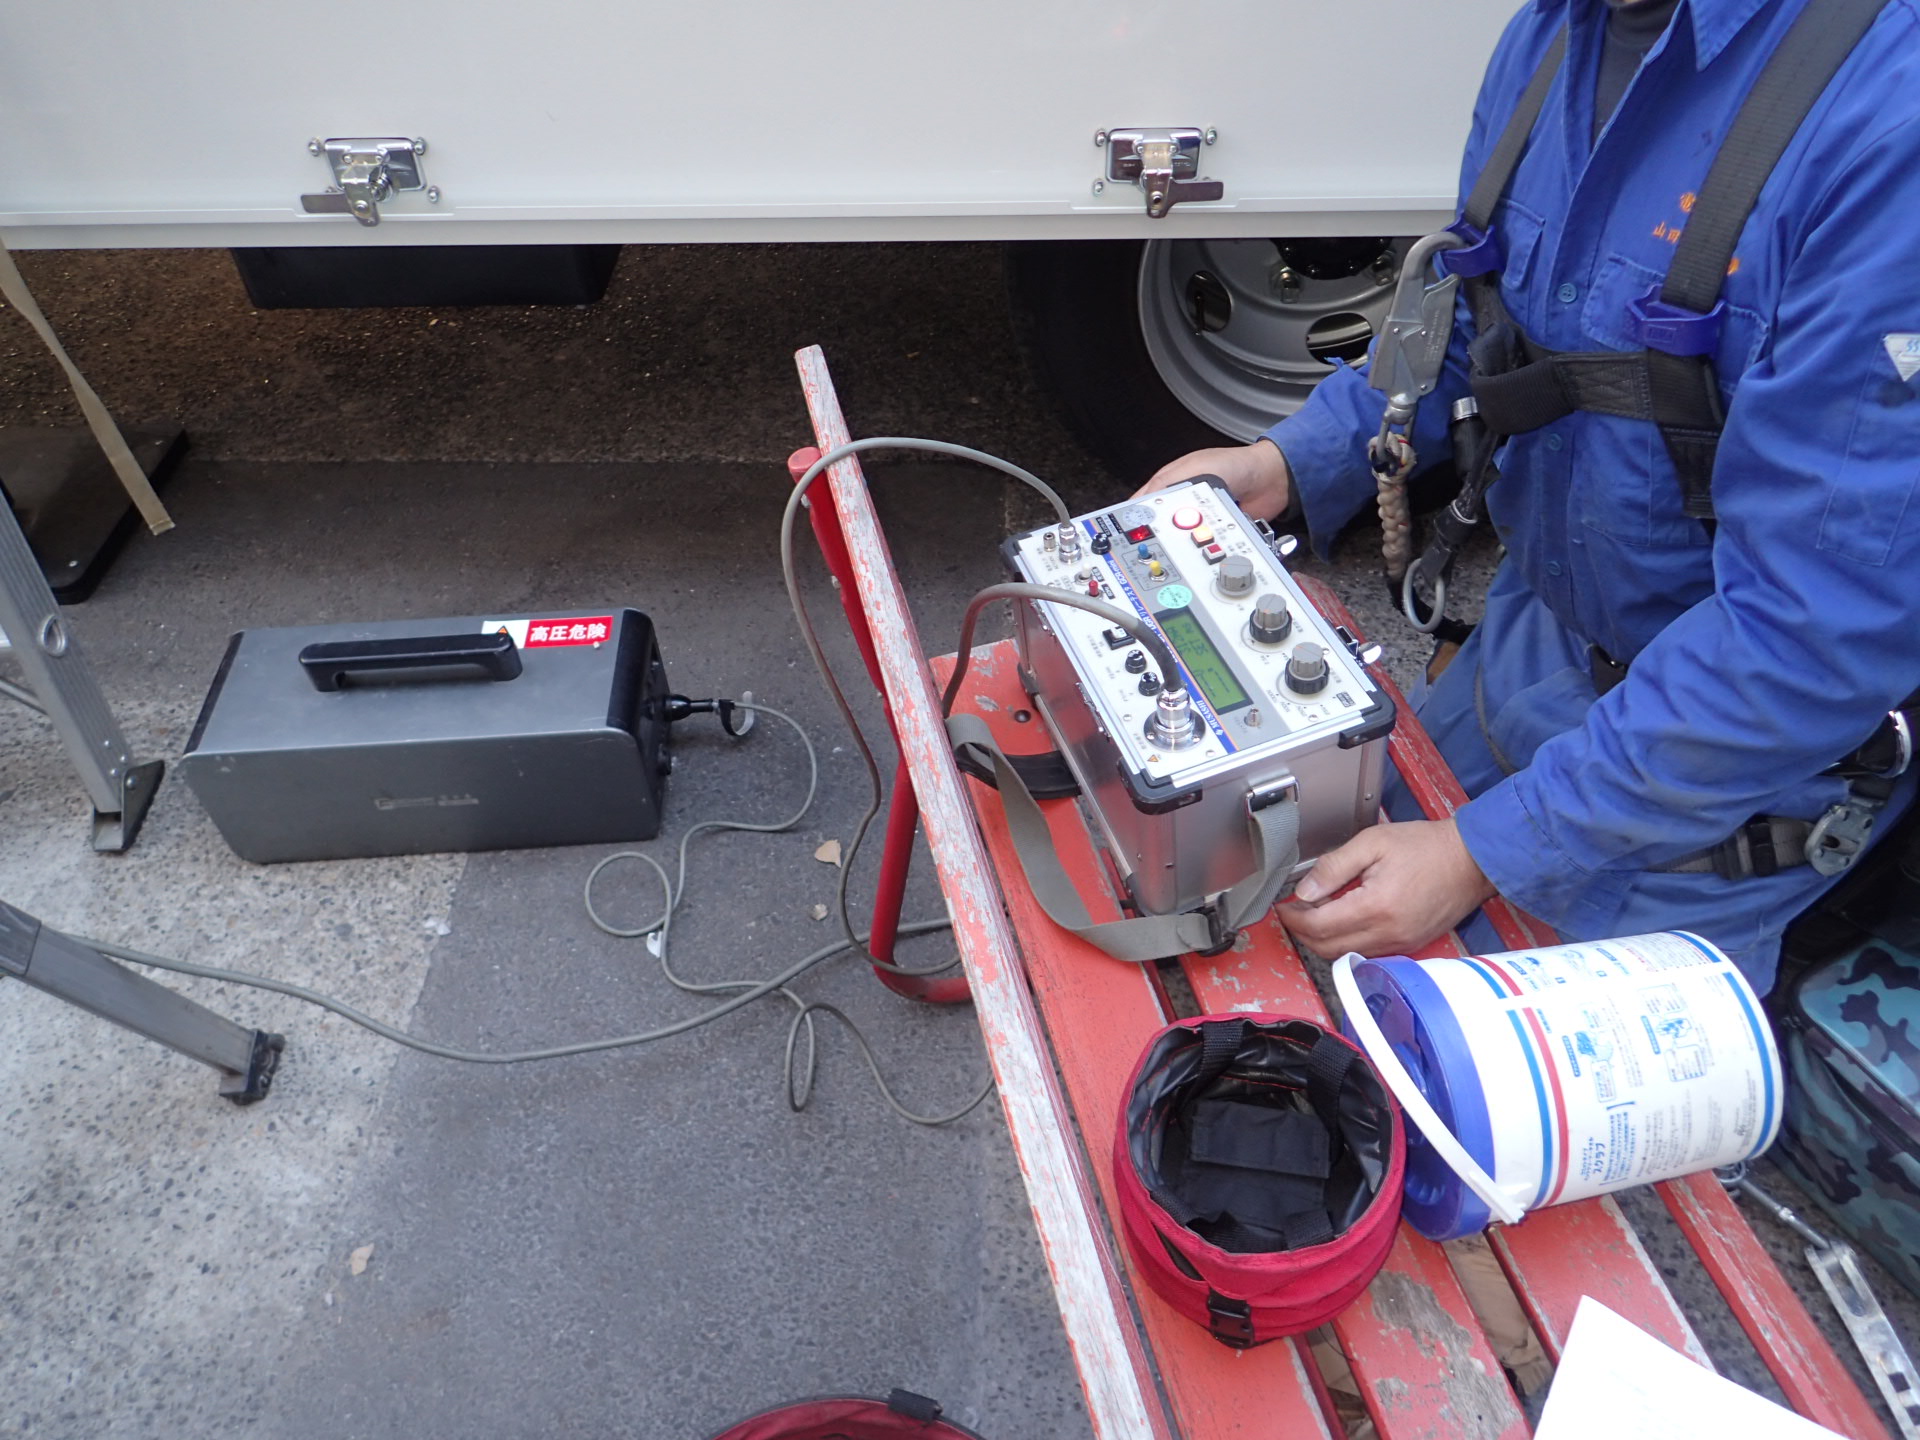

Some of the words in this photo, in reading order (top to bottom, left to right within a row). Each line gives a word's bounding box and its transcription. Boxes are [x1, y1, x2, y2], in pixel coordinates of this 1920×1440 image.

[529, 622, 607, 642] 高圧危険
[1196, 699, 1220, 728] MUSASHI
[1593, 1142, 1606, 1174] スクラブ
